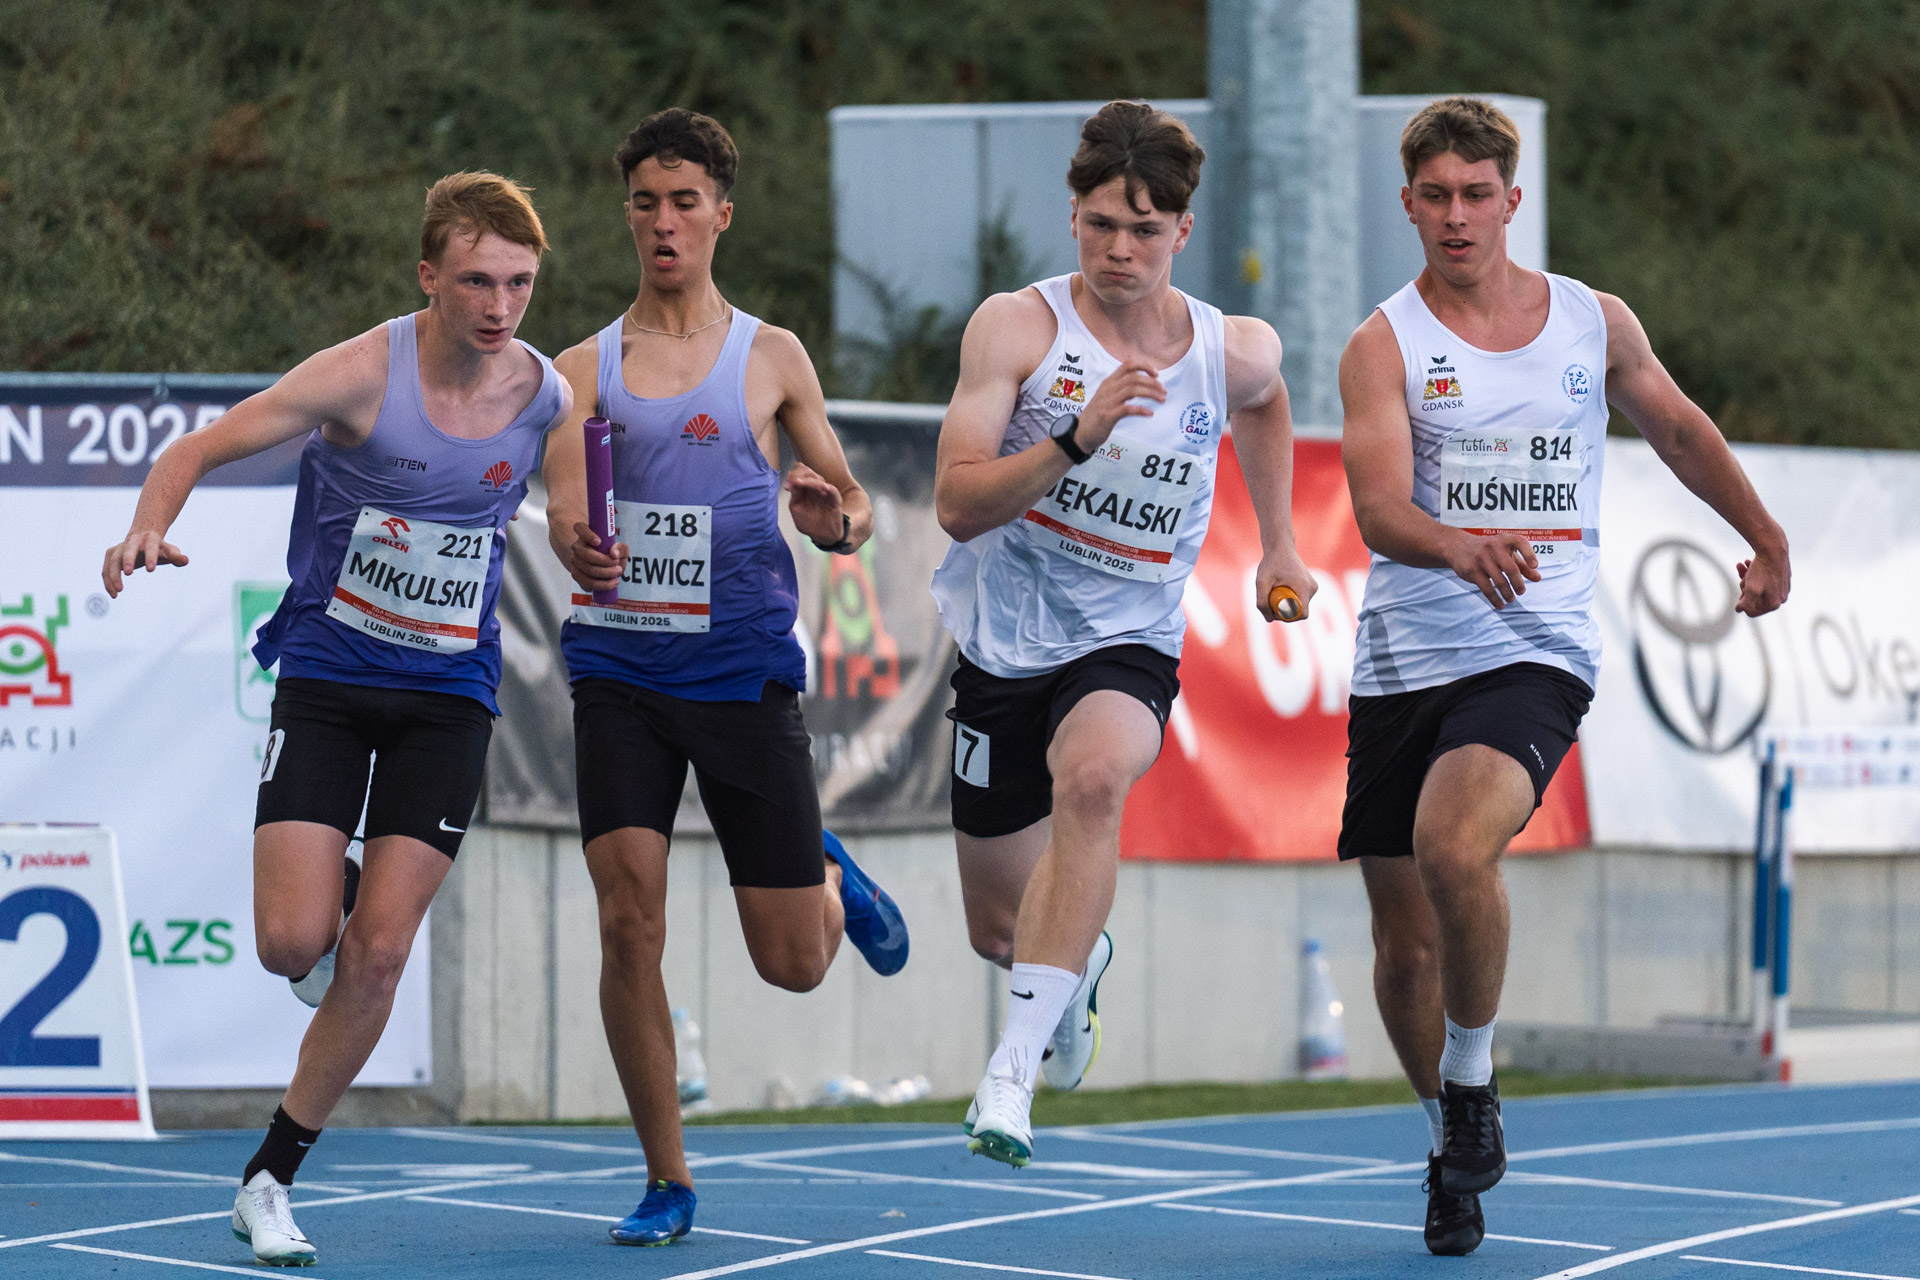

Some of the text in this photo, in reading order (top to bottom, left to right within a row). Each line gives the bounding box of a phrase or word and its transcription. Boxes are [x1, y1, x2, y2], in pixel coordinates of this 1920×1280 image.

[1058, 364, 1083, 376] erima
[1428, 366, 1456, 375] erima
[1043, 397, 1084, 413] GDAŃSK
[1421, 399, 1464, 412] GDAŃSK
[1570, 388, 1588, 396] GALA
[612, 423, 626, 434] EN
[1186, 425, 1209, 436] GALA
[1458, 438, 1492, 452] lublin
[1530, 436, 1572, 461] 814
[1140, 454, 1193, 485] 811
[1043, 477, 1182, 535] ĘKALSKI
[1446, 477, 1578, 512] KUŚNIEREK
[644, 511, 697, 538] 218
[371, 536, 410, 554] ORLEN
[436, 532, 483, 560] 221
[1059, 540, 1135, 572] LUBLIN 2025
[1532, 545, 1554, 554] 025
[348, 551, 479, 609] MIKULSKI
[621, 557, 706, 587] CEWICZ
[604, 612, 670, 626] LUBLIN 2025
[363, 619, 439, 648] LUBLIN 2025
[961, 728, 979, 777] 7
[1529, 743, 1546, 771] KIPSTA
[129, 918, 236, 967] AZS
[0, 883, 102, 1067] 2
